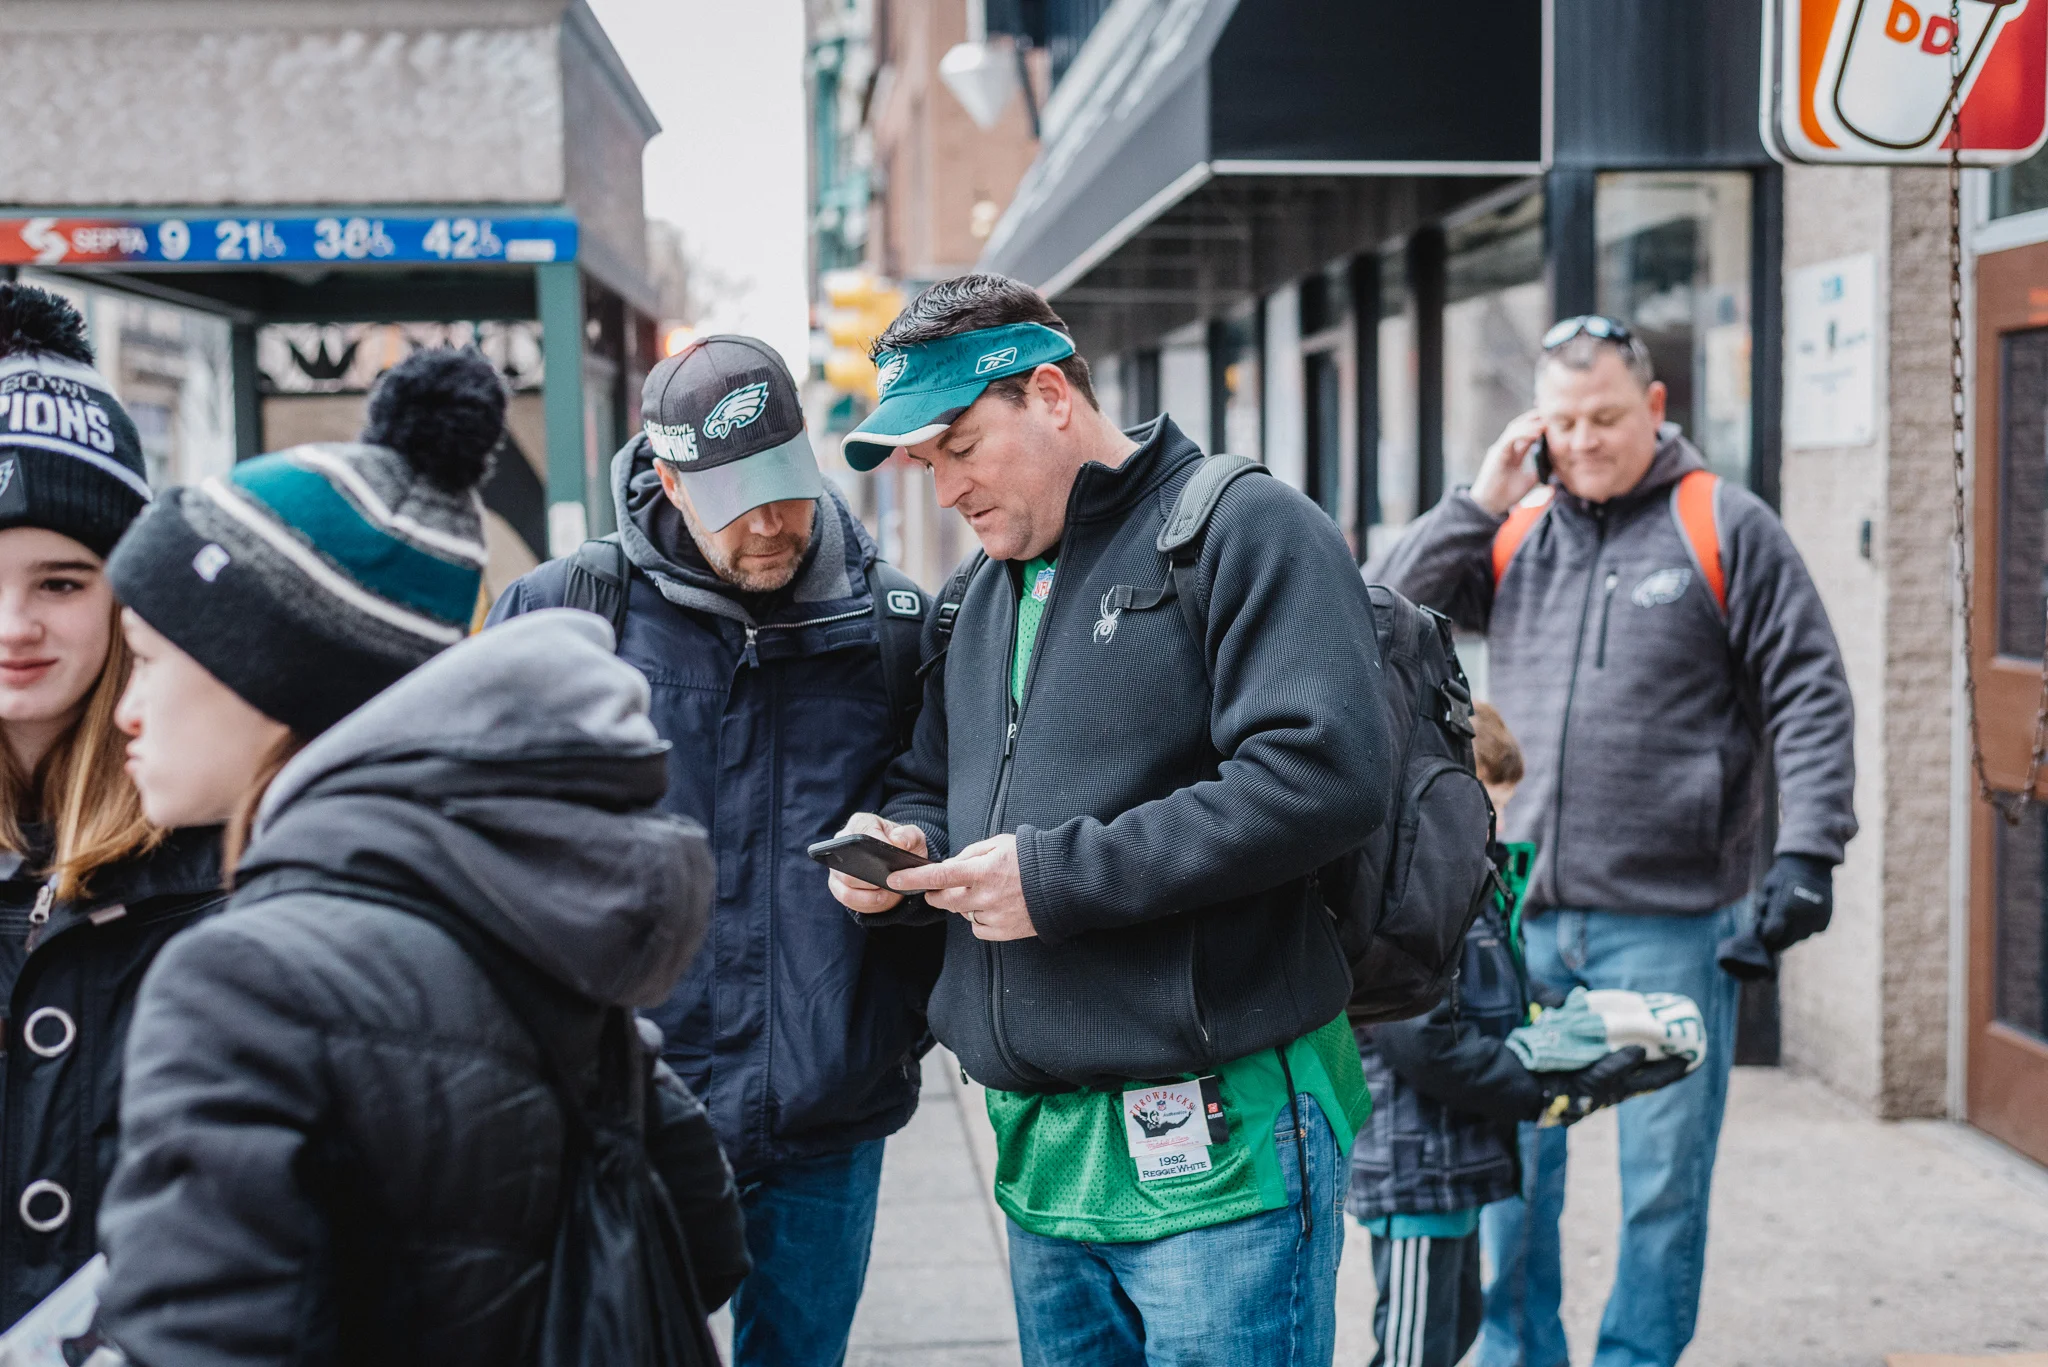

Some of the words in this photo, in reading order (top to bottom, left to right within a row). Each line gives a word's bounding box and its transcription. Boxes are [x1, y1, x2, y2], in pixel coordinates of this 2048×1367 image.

[72, 227, 148, 254] SEPTA
[158, 219, 191, 260] 9
[215, 220, 262, 261] 21
[422, 219, 478, 260] 42
[1, 372, 100, 405] BOWL
[665, 423, 695, 435] BOWL
[1034, 582, 1049, 596] NFL
[1130, 1091, 1195, 1117] THROWBACKS
[1159, 1154, 1187, 1166] 1992
[1142, 1166, 1176, 1179] REGGIE
[1176, 1161, 1208, 1172] WHITE
